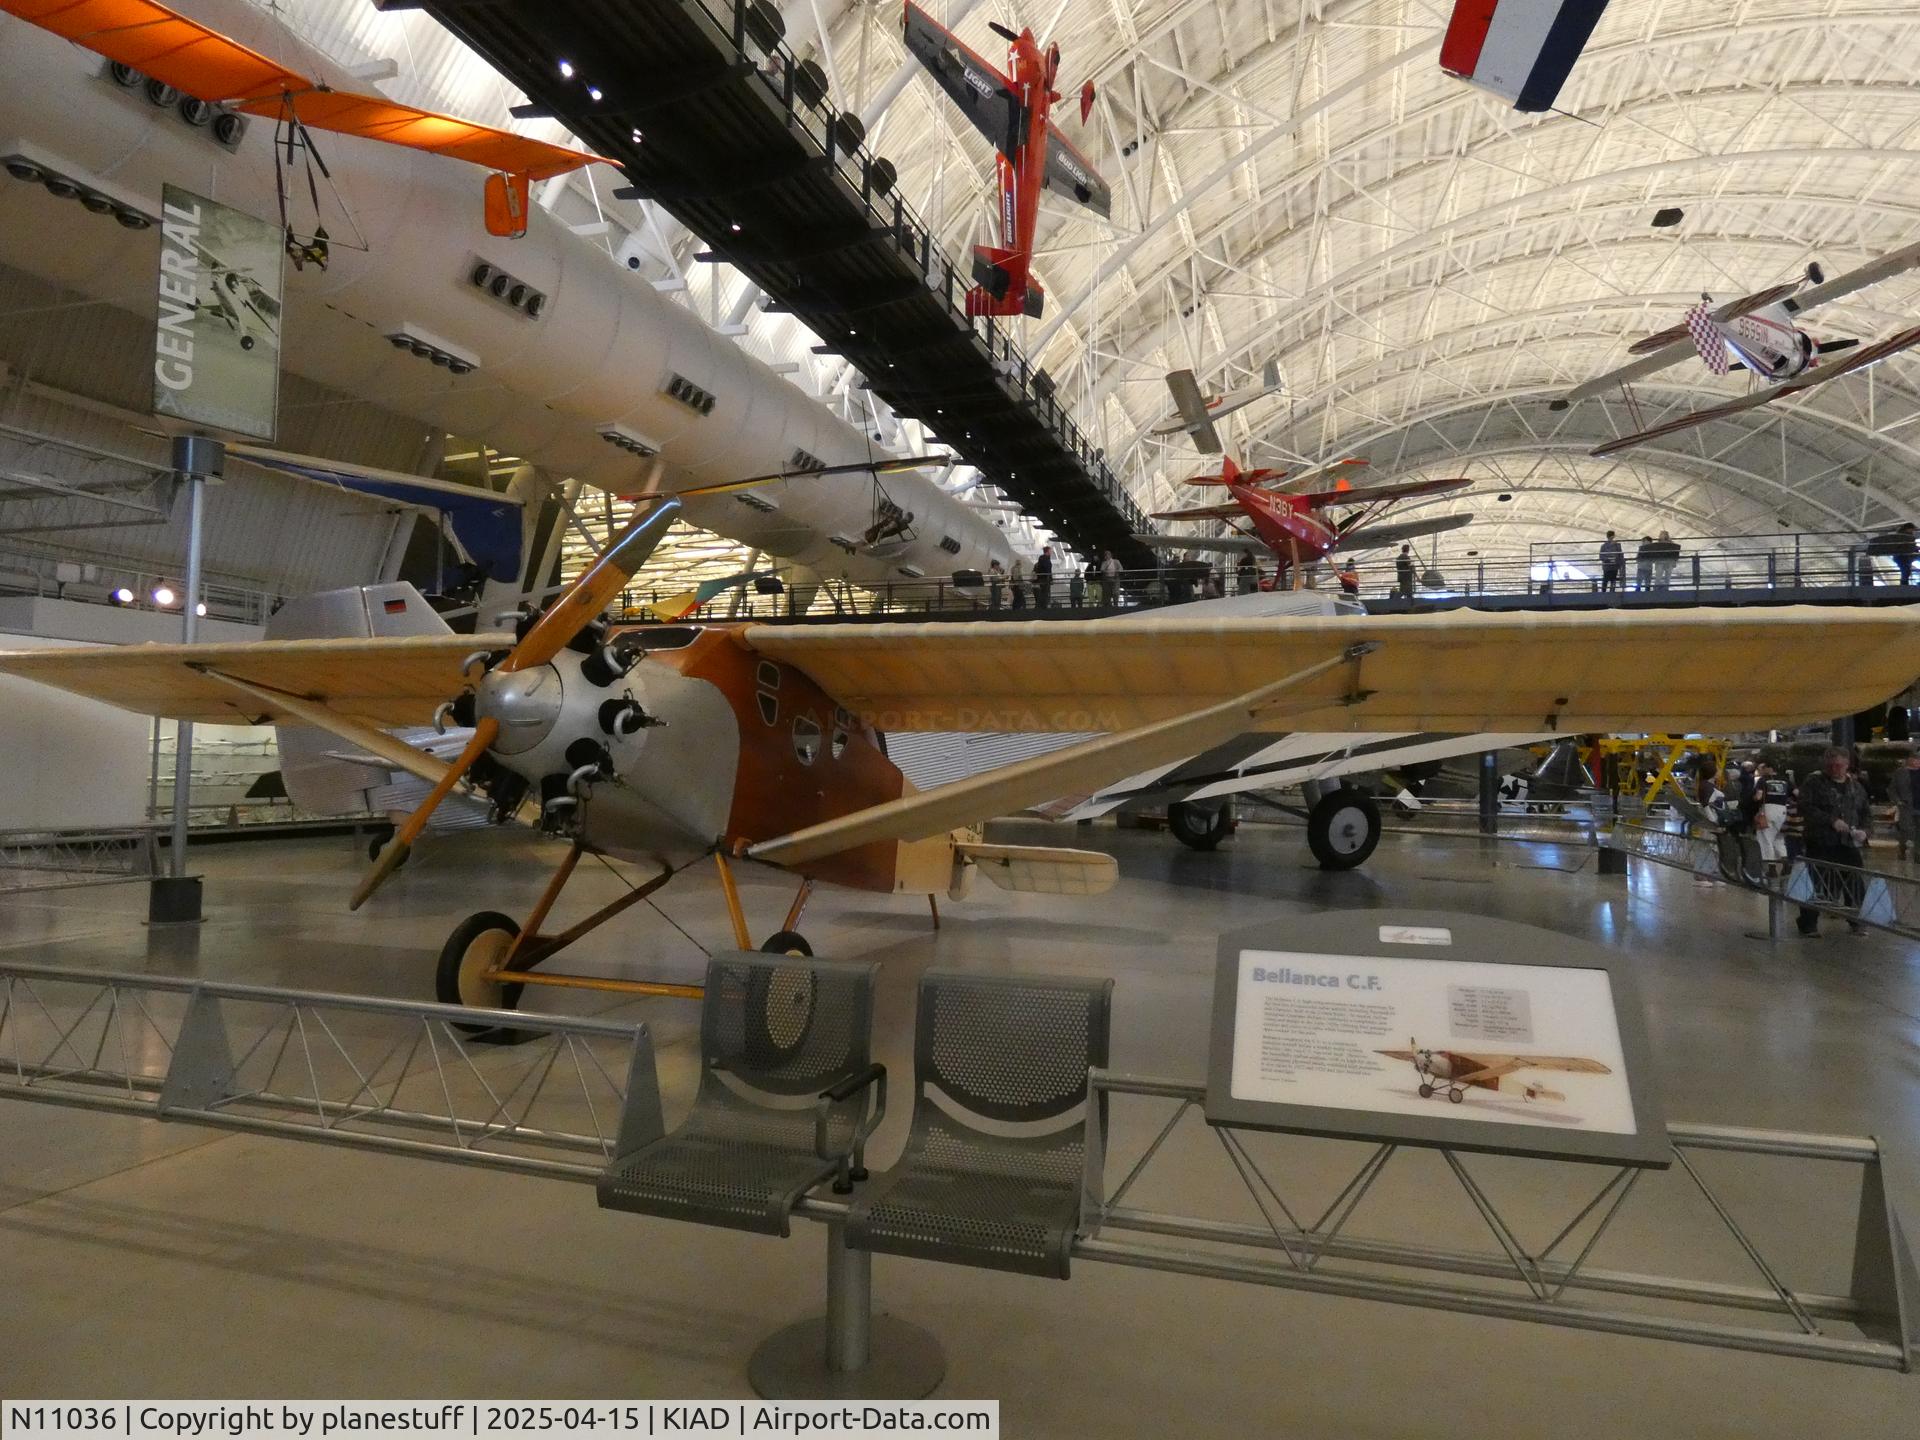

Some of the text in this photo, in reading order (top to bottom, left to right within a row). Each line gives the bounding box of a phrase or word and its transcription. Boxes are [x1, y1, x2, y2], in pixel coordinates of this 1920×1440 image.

[964, 66, 993, 95] LIGHT
[1058, 153, 1088, 185] BUD LIGH
[155, 203, 200, 391] GENERAL
[1269, 495, 1294, 519] N36Y
[1252, 967, 1382, 991] Bellanca C.F.
